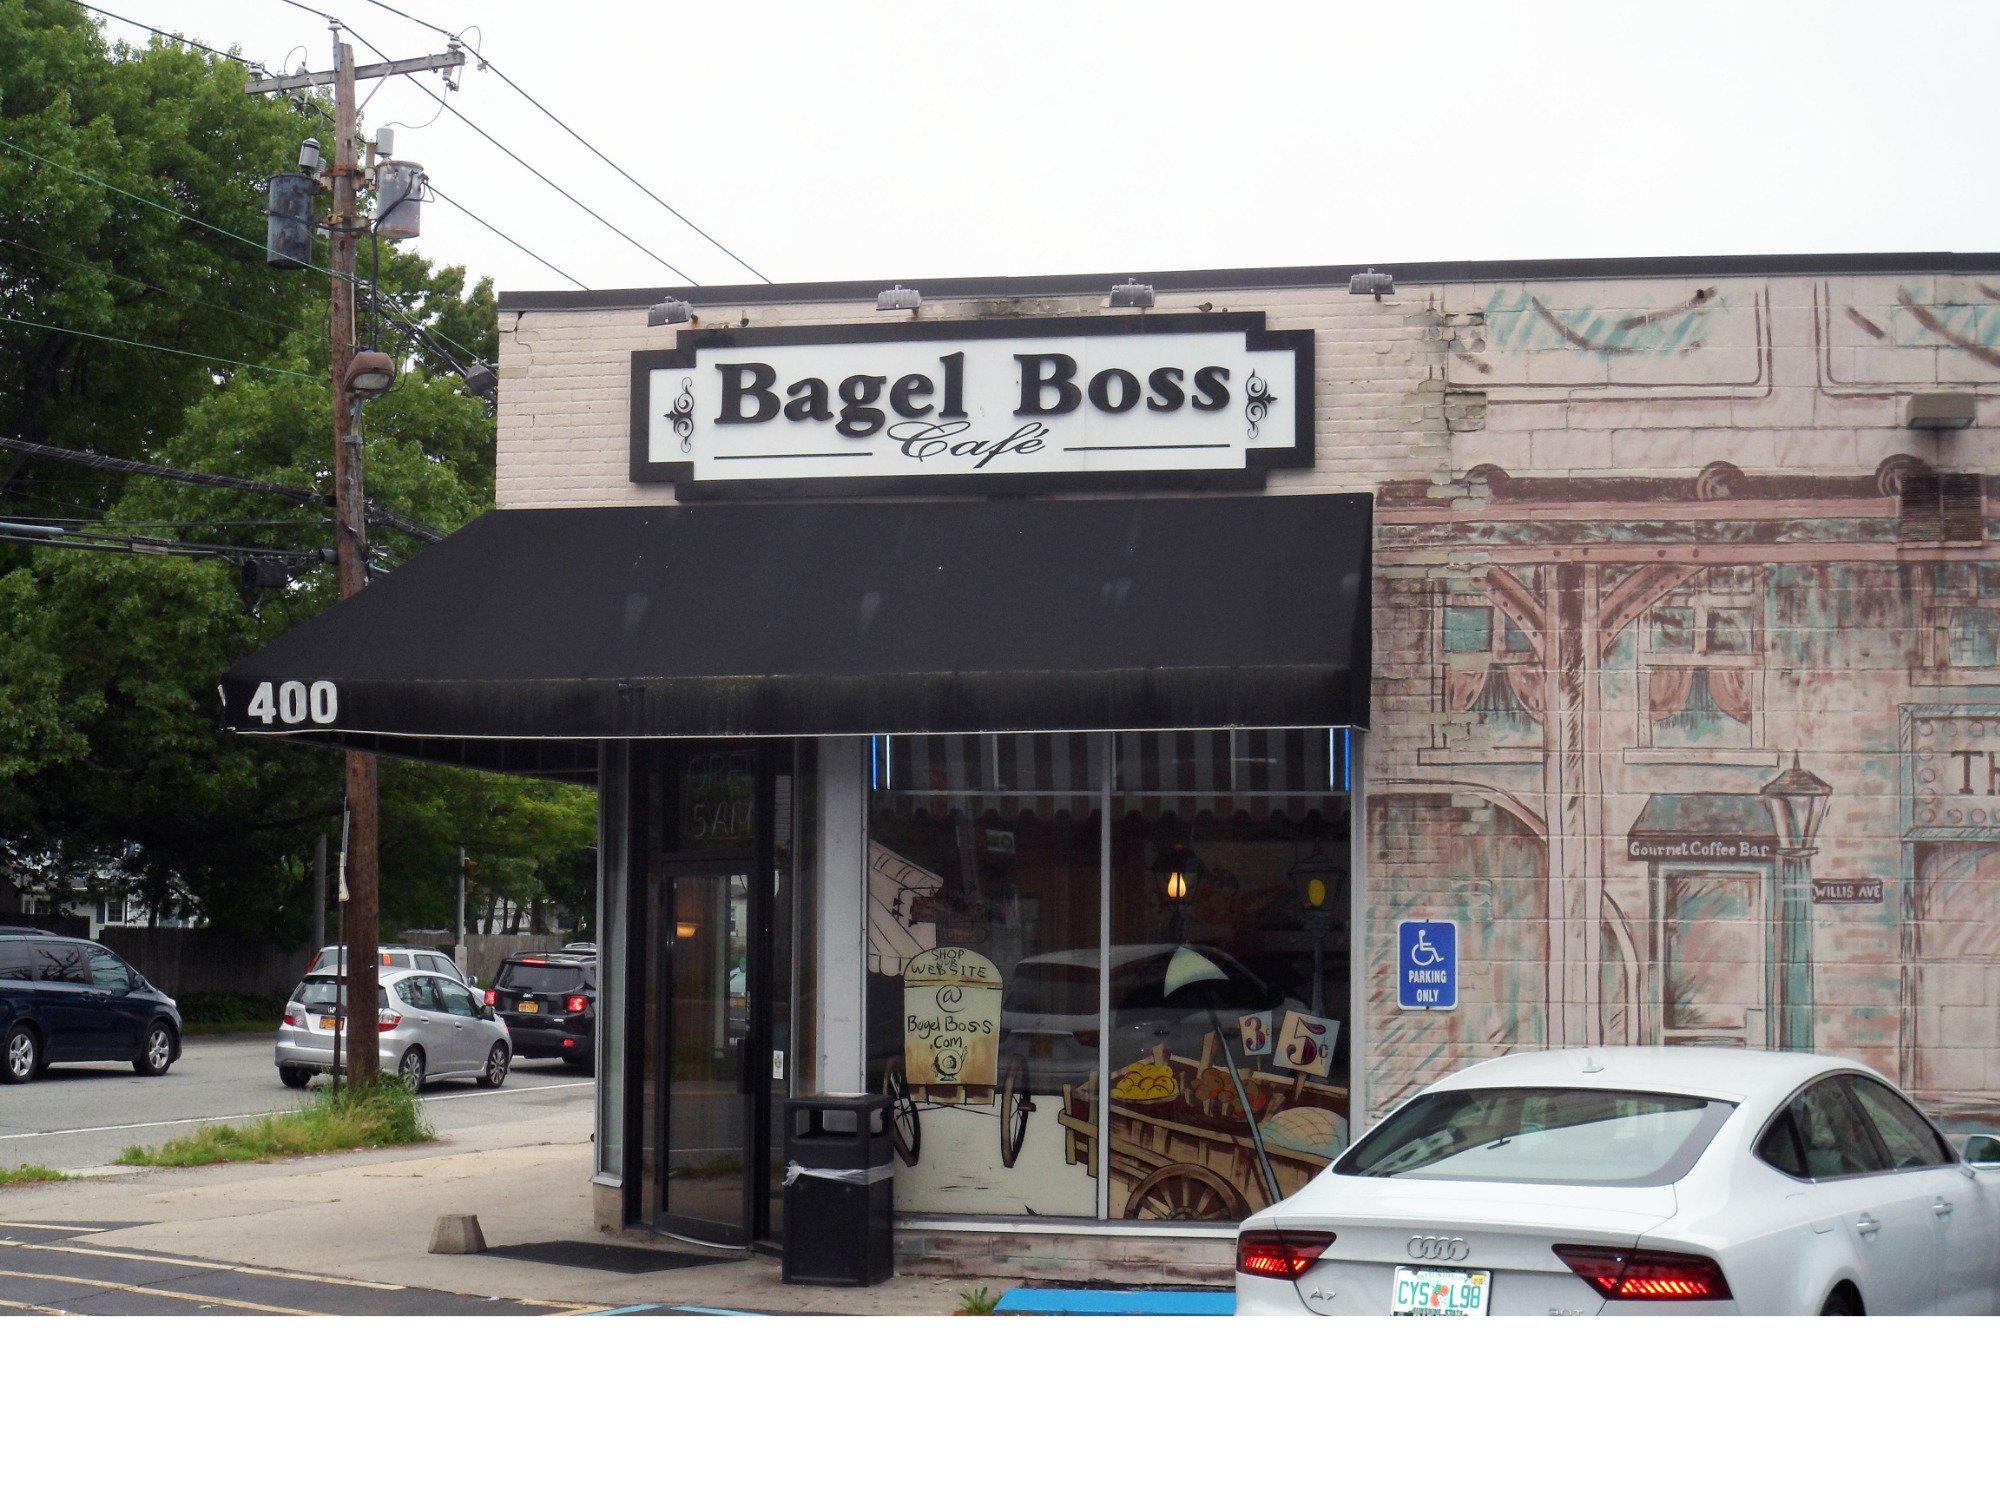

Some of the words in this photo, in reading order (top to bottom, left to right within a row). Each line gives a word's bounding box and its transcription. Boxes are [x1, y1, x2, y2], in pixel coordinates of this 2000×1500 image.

[714, 351, 967, 438] Bagel
[1013, 353, 1230, 416] Boss
[887, 421, 1050, 469] Café
[248, 681, 338, 724] 400
[1690, 841, 1736, 856] Coffee
[1739, 842, 1770, 857] Bar
[1814, 885, 1854, 899] WILLIS
[1858, 885, 1880, 898] AVE
[931, 949, 965, 960] SHOP
[911, 964, 987, 979] WEBSITE
[1408, 970, 1447, 984] PARKING
[936, 985, 966, 1014] @
[1416, 989, 1439, 1002] ONLY
